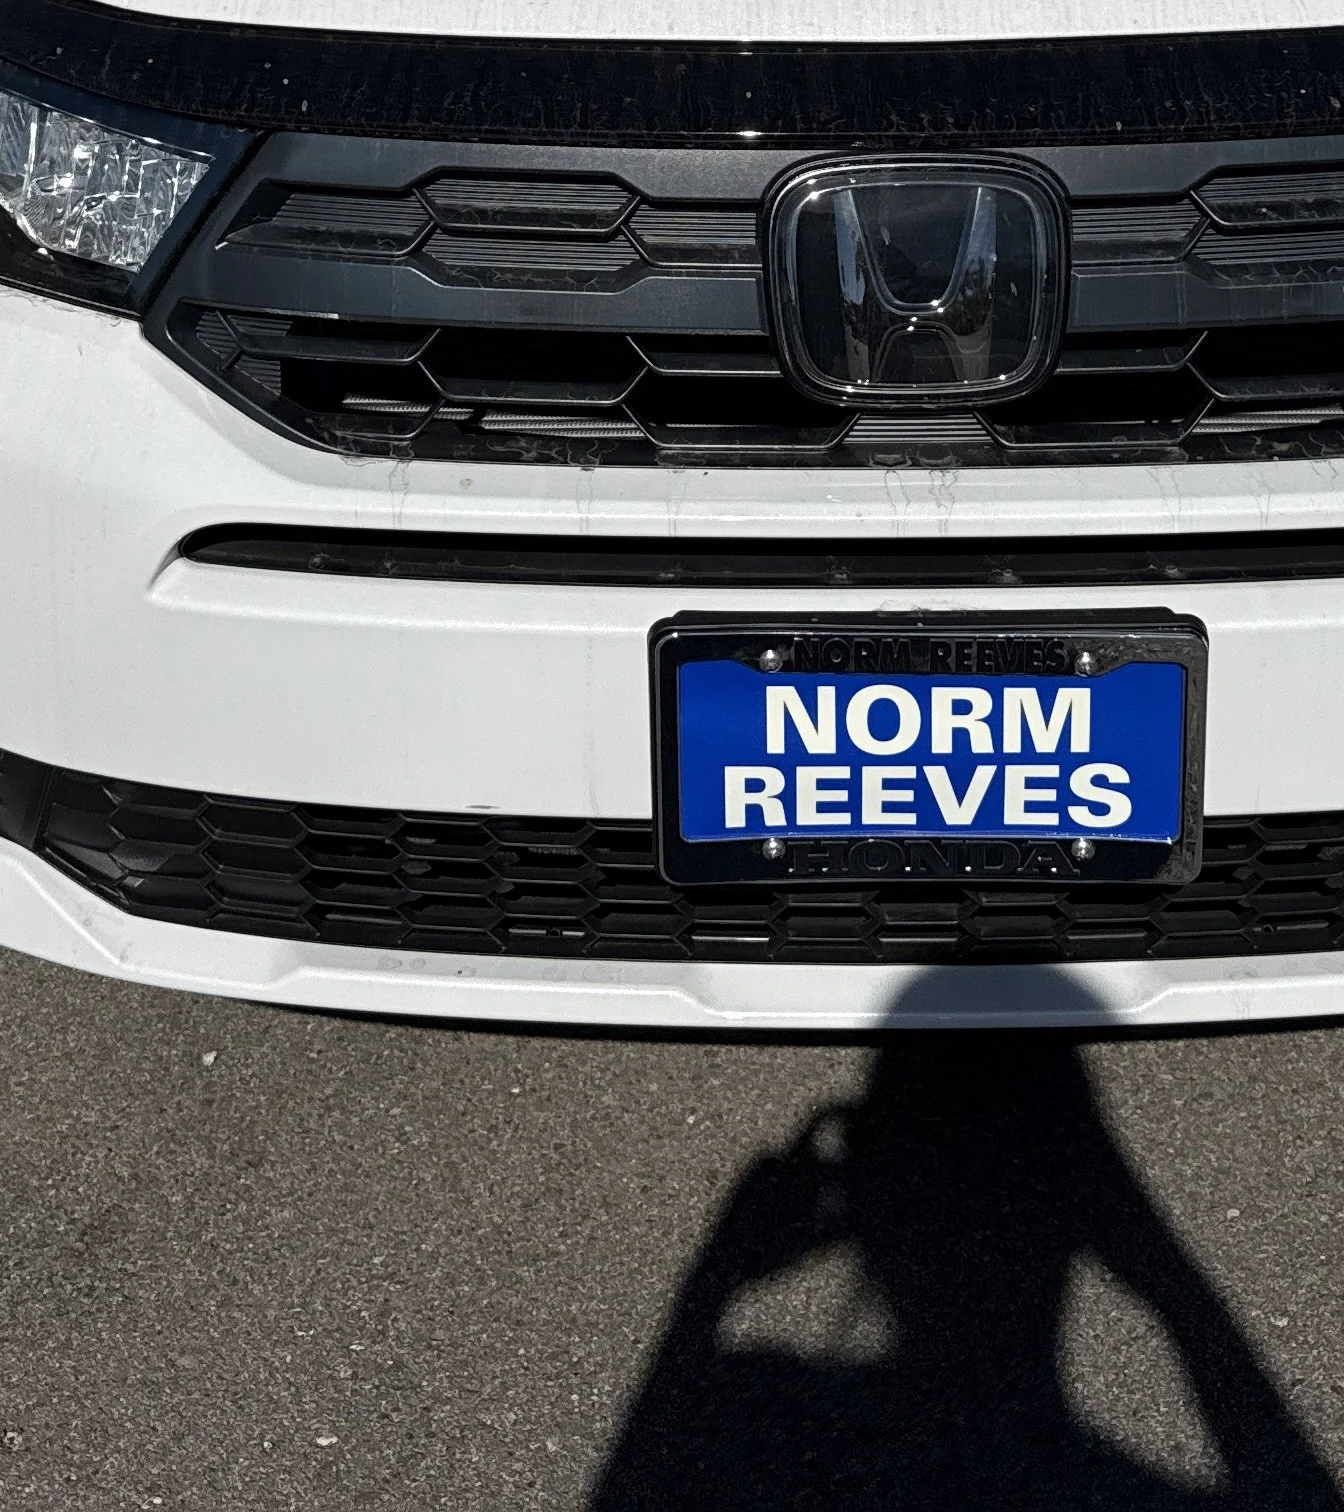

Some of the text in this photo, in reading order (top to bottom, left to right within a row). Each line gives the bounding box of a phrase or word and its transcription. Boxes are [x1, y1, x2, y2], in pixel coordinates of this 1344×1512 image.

[794, 638, 1067, 674] NORM REEVES
[764, 684, 1092, 756] NORM
[723, 763, 1133, 828] REEVES
[789, 840, 1081, 875] HONDA
